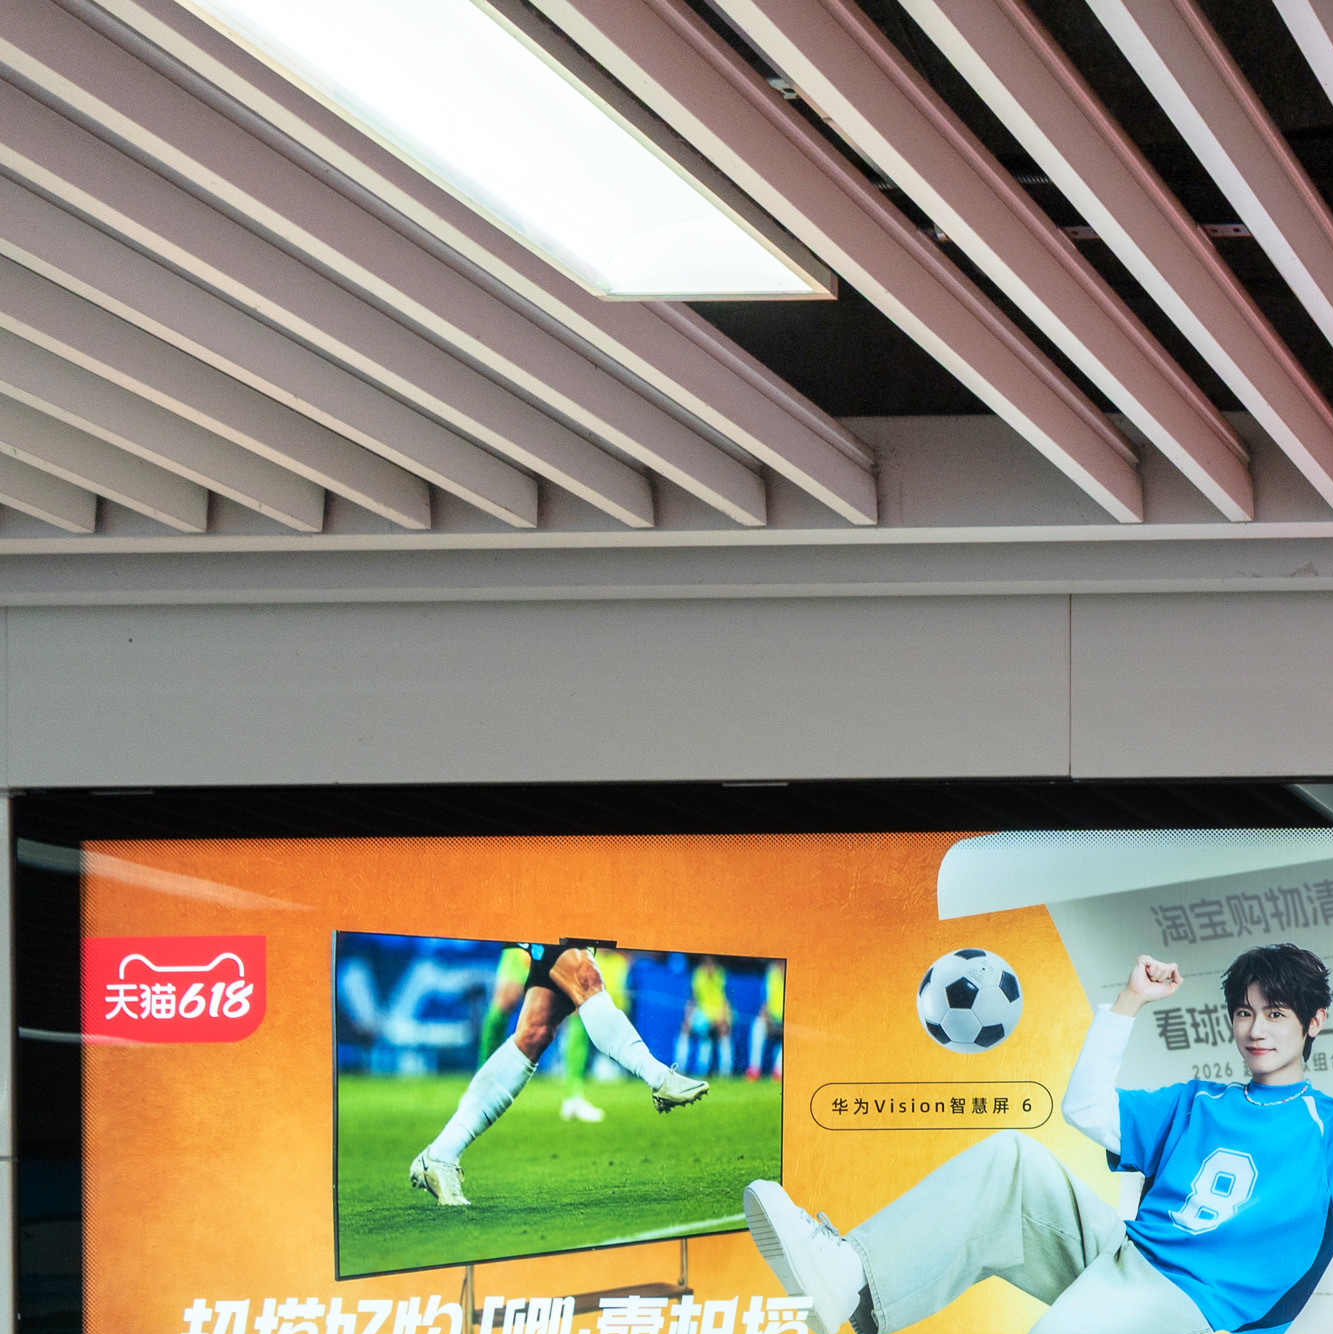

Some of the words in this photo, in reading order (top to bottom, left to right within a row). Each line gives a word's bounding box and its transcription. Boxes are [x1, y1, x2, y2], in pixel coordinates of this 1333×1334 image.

[105, 981, 254, 1020] 天猫618
[1192, 1061, 1233, 1080] 2026
[832, 1097, 1009, 1115] 华为Vision智慧屏
[1023, 1099, 1031, 1112] 6
